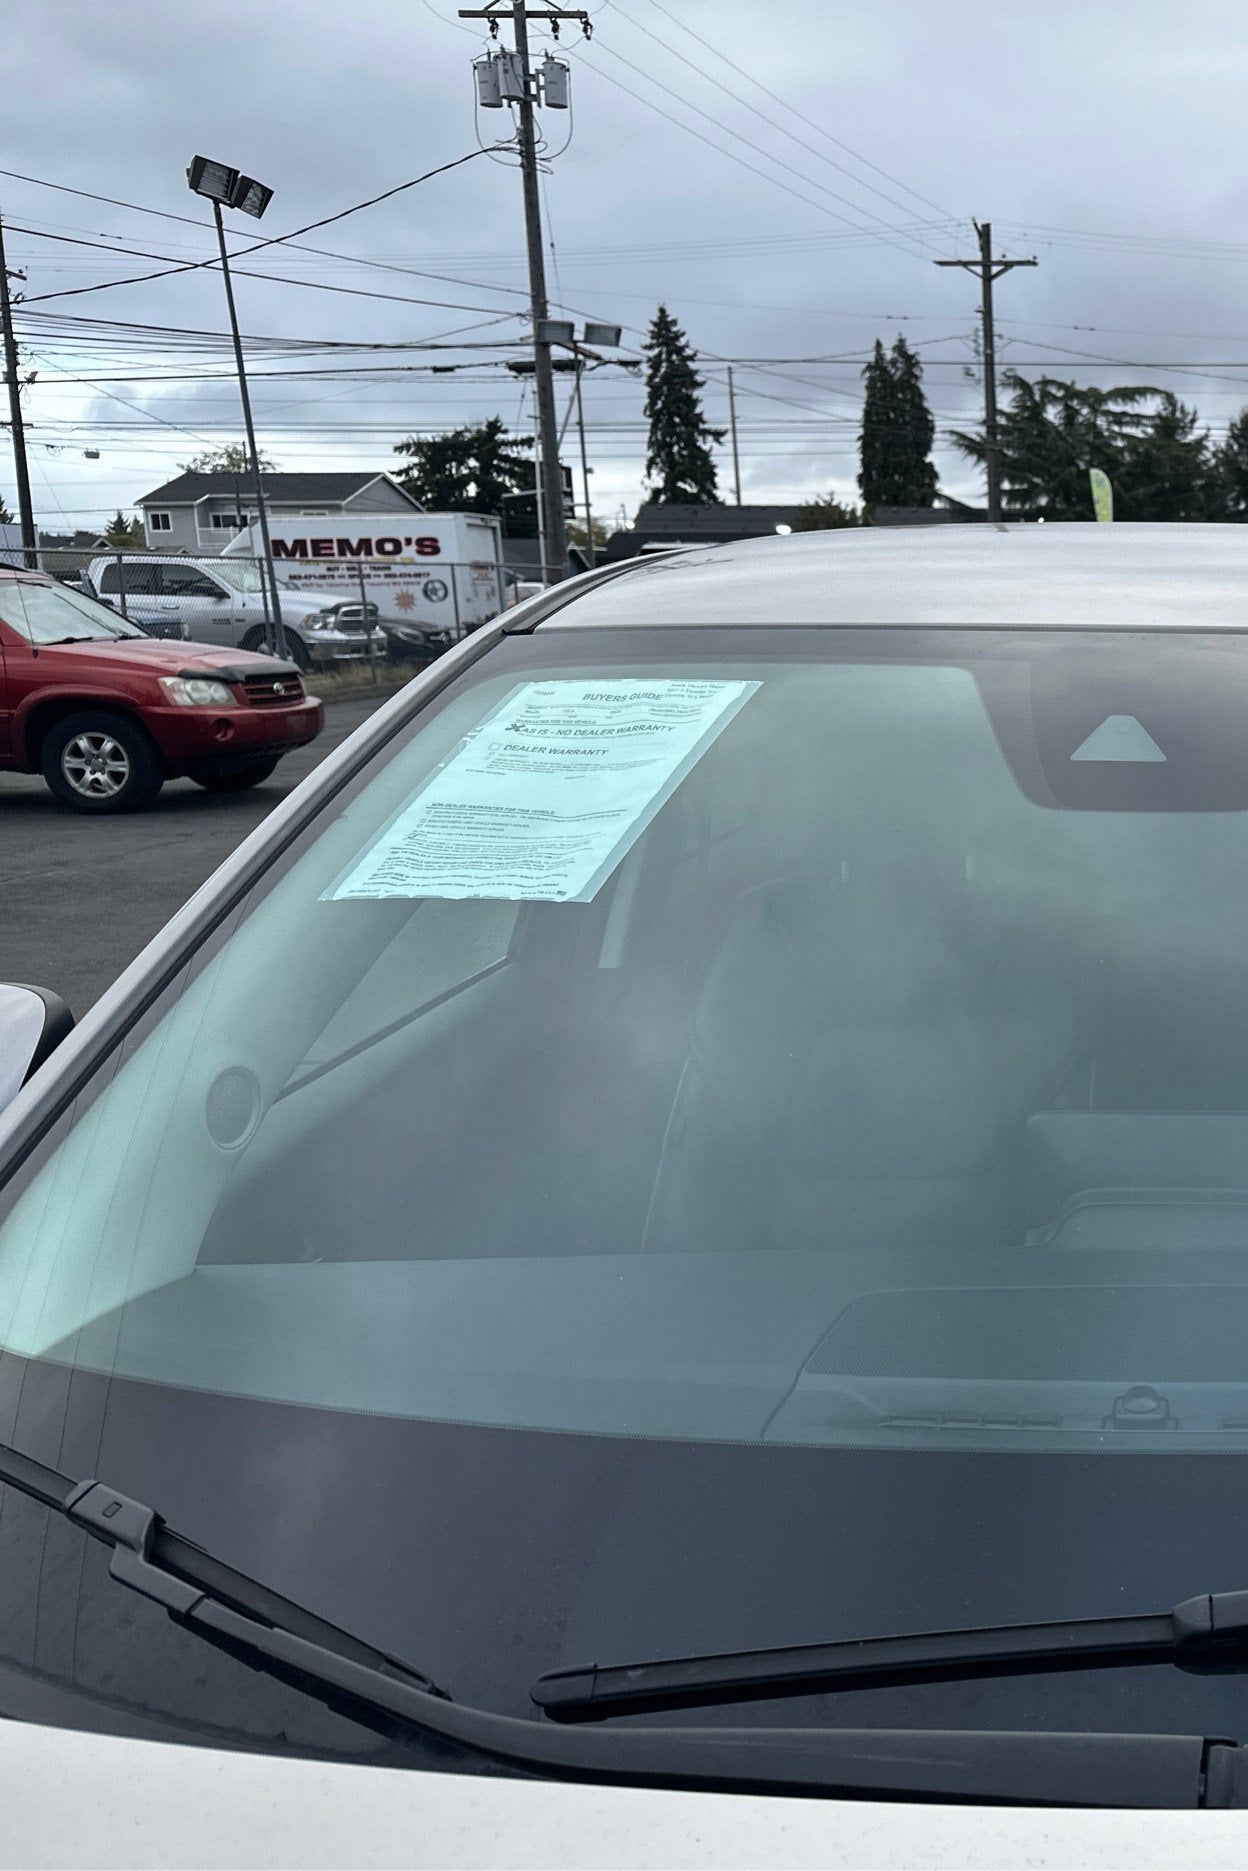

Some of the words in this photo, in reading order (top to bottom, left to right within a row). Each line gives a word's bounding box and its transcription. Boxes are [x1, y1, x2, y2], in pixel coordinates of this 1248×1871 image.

[271, 536, 441, 558] MEMO'S
[582, 693, 628, 702] BUYERS
[629, 692, 663, 701] GUIDE
[573, 728, 616, 736] DEALER
[616, 724, 676, 734] WARRANTY
[503, 744, 547, 753] DEALER
[549, 748, 610, 756] WARRANTY
